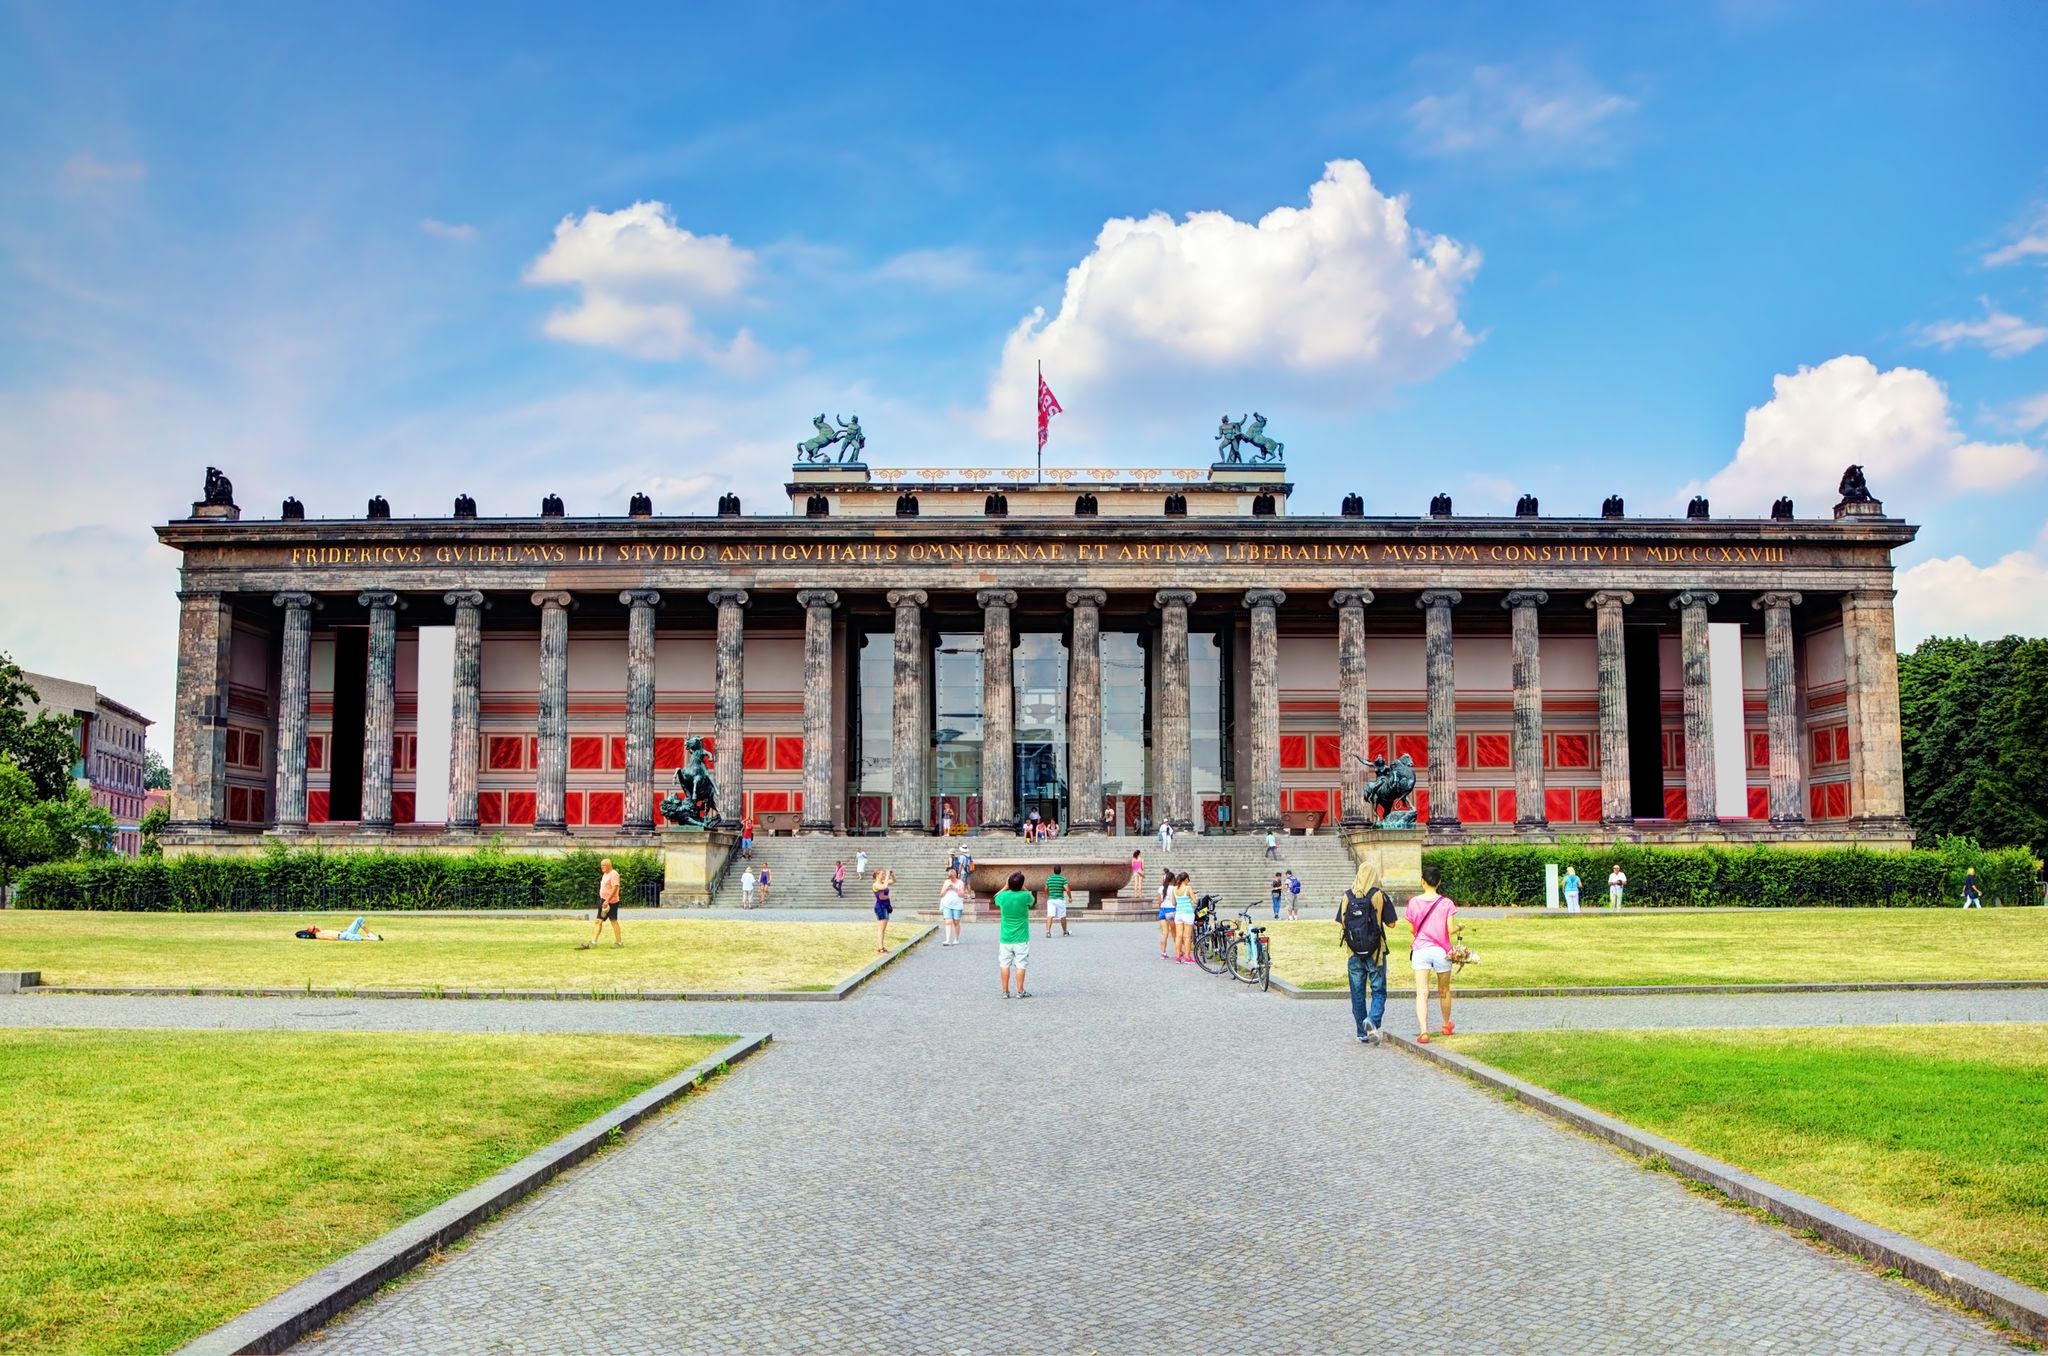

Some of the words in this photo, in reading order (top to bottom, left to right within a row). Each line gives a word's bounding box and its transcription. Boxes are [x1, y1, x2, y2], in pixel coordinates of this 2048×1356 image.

[291, 547, 422, 563] FRIDERICVS
[436, 546, 565, 562] GVILELMVS
[578, 546, 604, 561] III
[617, 545, 705, 561] STVDIO
[719, 544, 898, 561] ANTIQVITATIS
[909, 544, 1065, 560] OMNIGENAE
[1078, 544, 1109, 560] ET
[1117, 544, 1213, 560] ARTIVM
[1224, 544, 1370, 560] LIBERALIVM
[1381, 545, 1480, 561] MVSEVM
[1490, 546, 1635, 562] CONSTITVIT
[1644, 546, 1784, 562] MDCCCXXVIII
